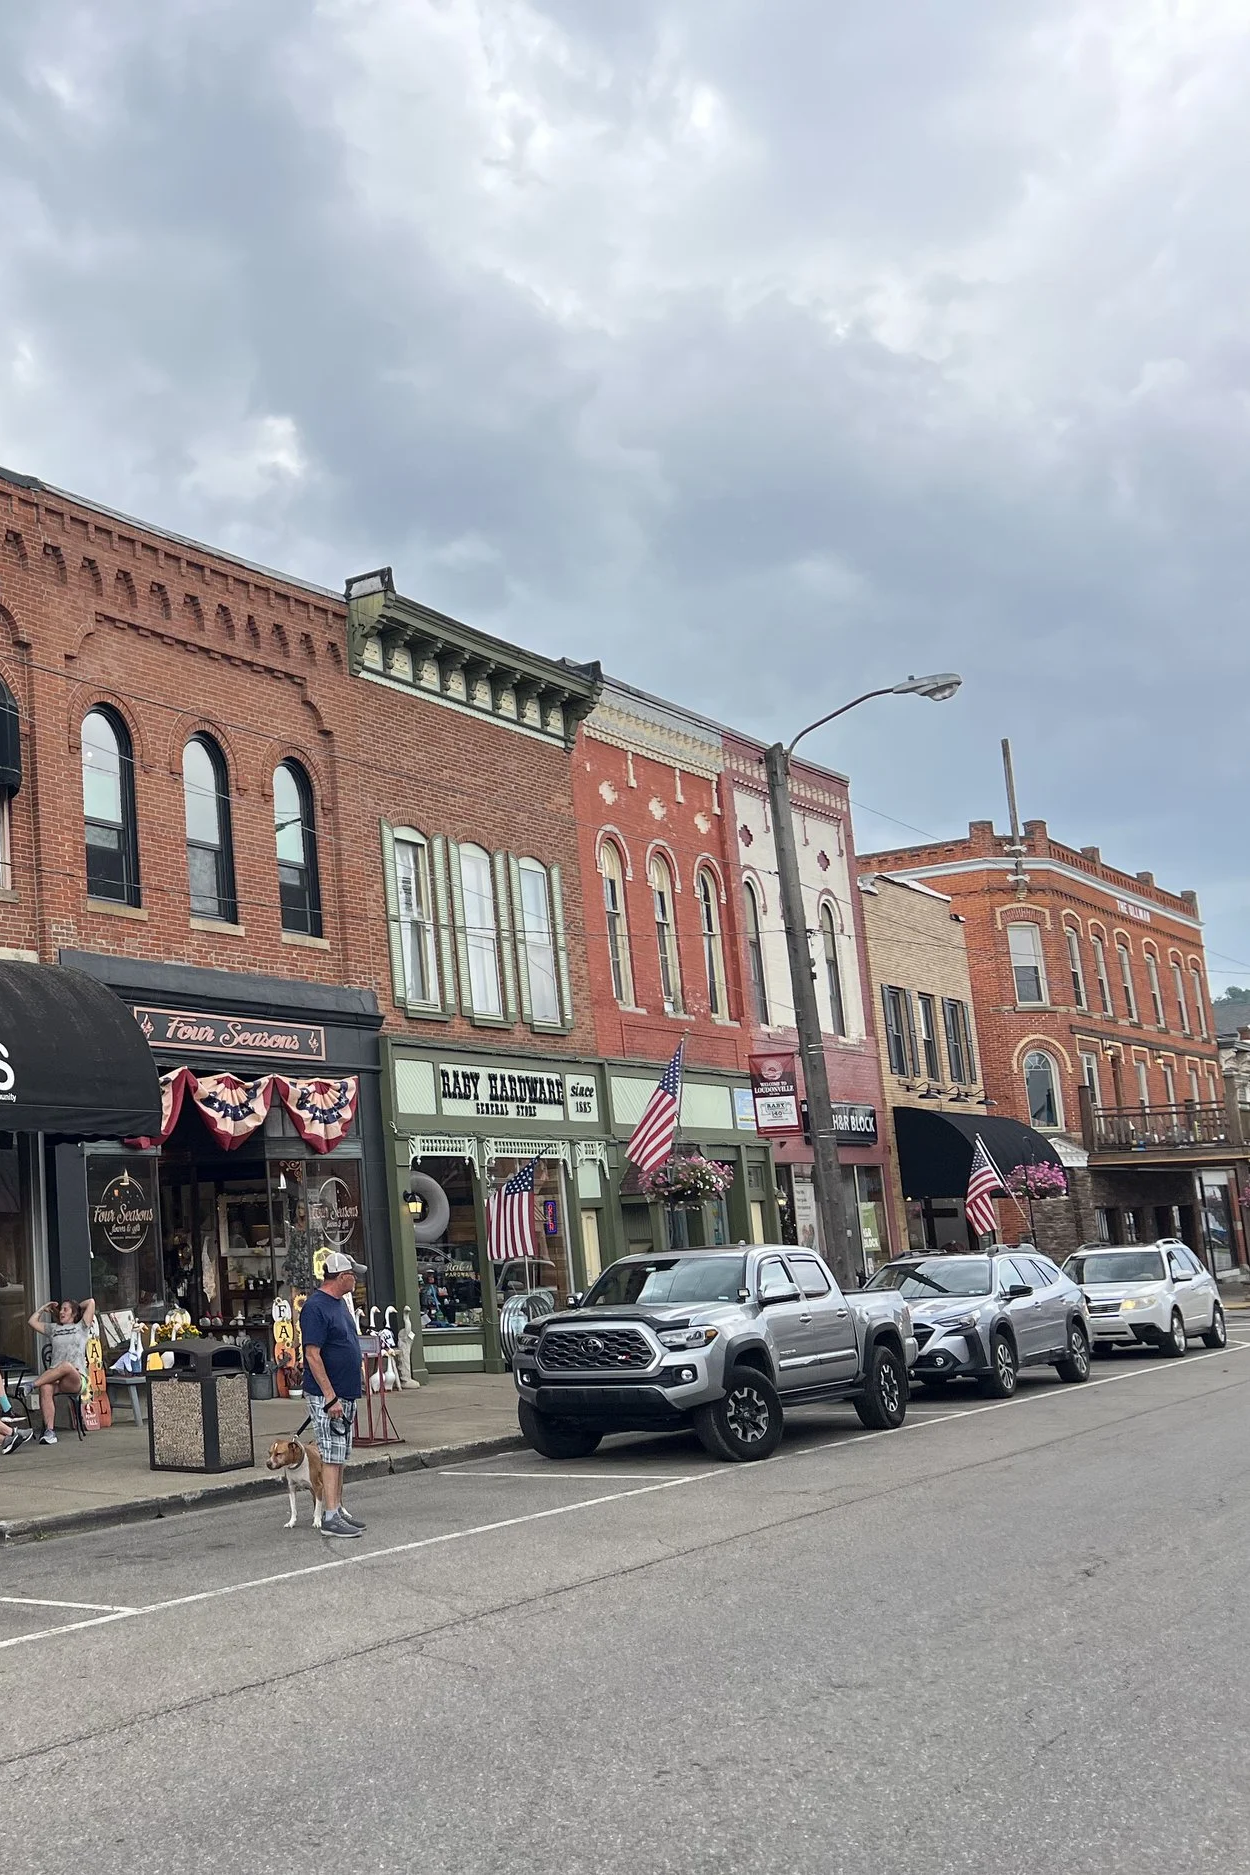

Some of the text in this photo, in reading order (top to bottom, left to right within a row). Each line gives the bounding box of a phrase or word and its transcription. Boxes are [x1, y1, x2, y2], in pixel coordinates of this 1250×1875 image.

[166, 1016, 300, 1050] Four Seasons
[441, 1069, 565, 1105] RABY HARDWARE
[570, 1082, 594, 1098] since
[754, 1085, 795, 1094] LOUDONVILLE
[476, 1102, 537, 1117] GENERAL STORE
[832, 1115, 876, 1133] H&R BLOCK
[93, 1203, 154, 1224] Four Seasons
